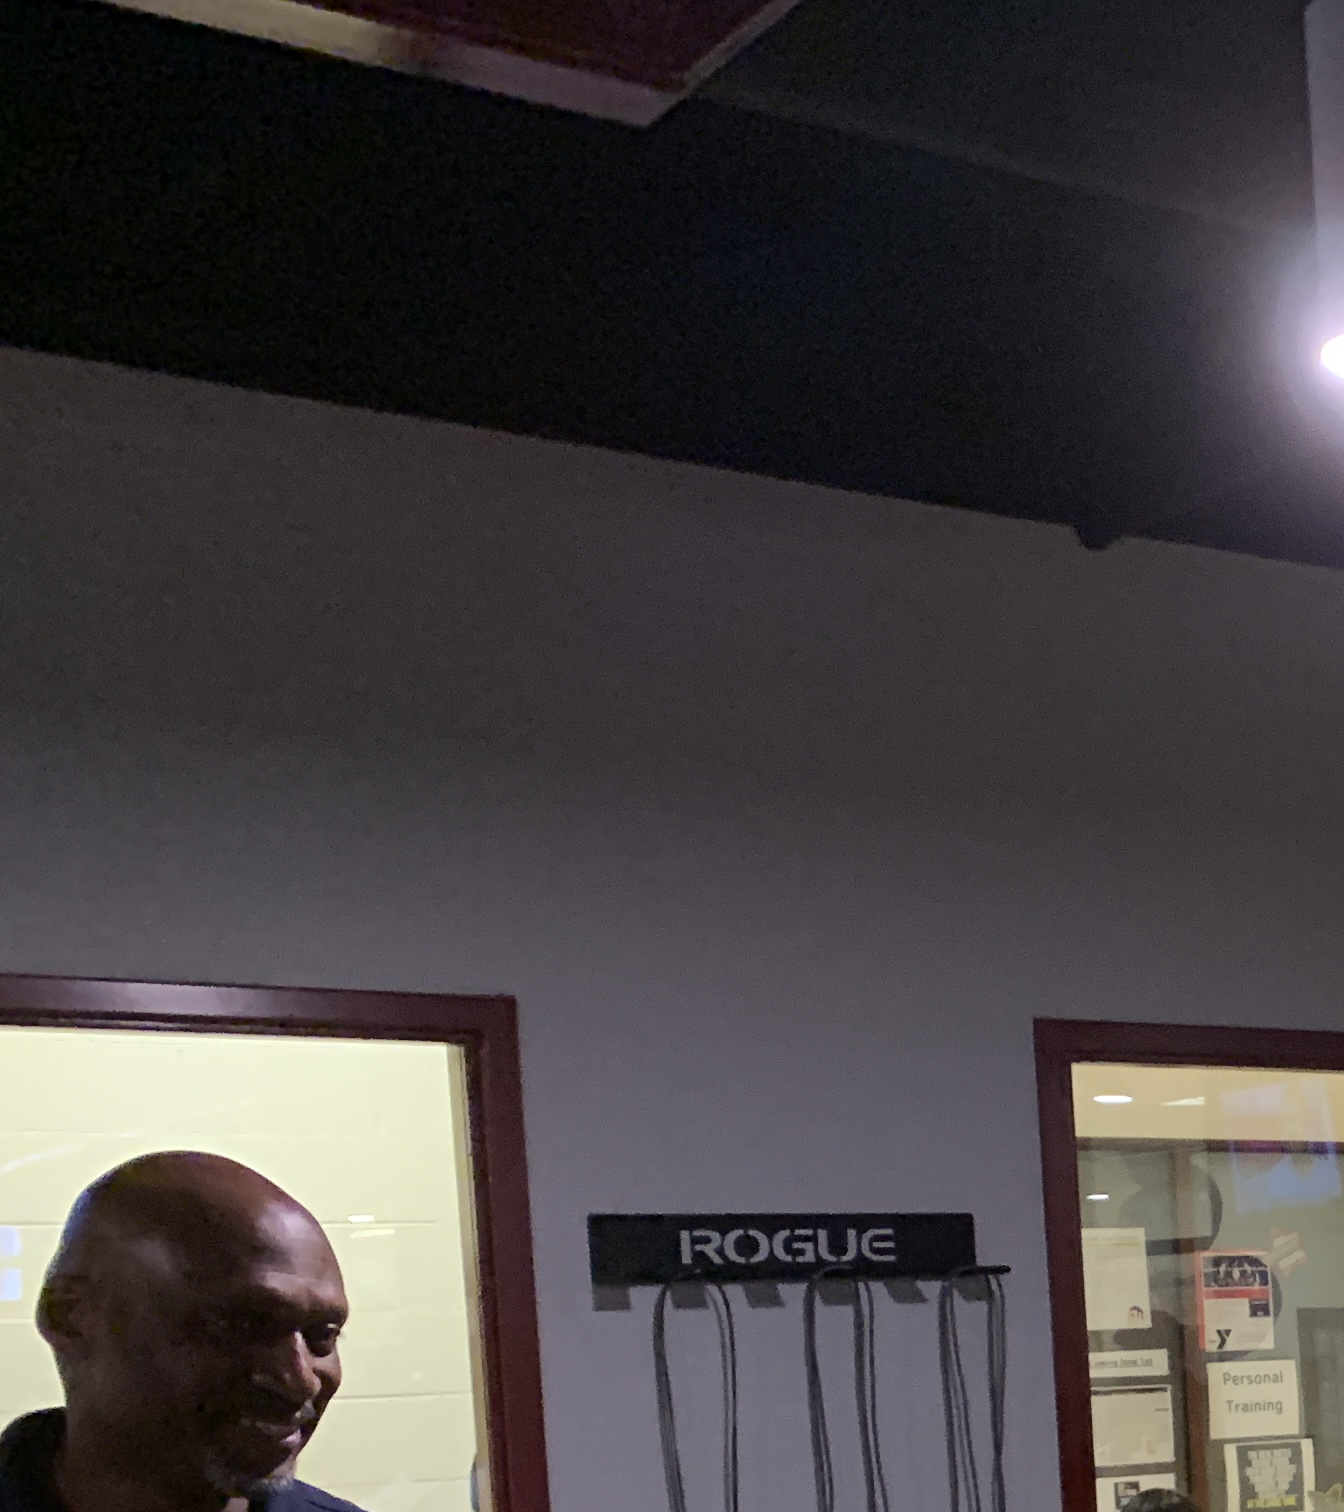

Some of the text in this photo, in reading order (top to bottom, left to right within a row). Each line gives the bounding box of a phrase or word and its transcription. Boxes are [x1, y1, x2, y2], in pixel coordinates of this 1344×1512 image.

[678, 1228, 897, 1265] ROGUE
[1221, 1369, 1284, 1387] Personal
[1225, 1399, 1284, 1415] Training
